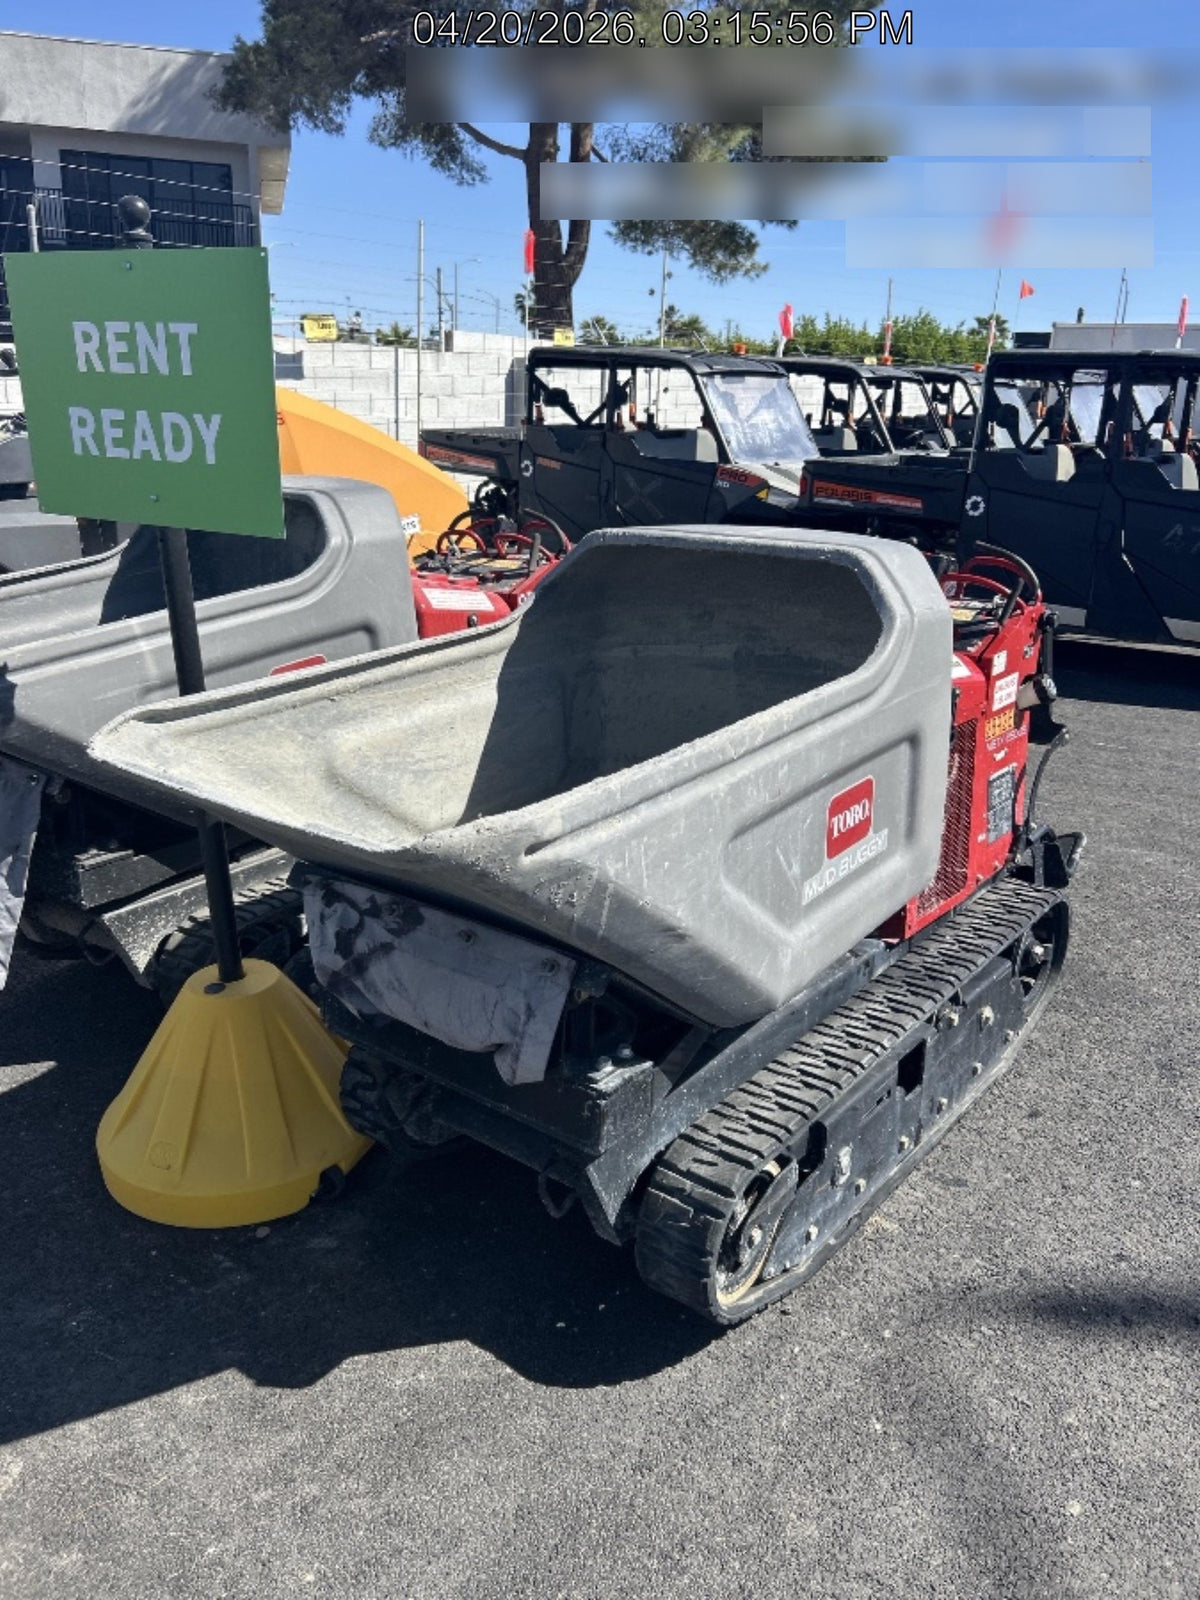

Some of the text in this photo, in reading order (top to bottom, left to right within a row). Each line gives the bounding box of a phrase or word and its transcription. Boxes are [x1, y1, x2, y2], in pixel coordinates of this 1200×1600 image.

[72, 321, 198, 376] RENT
[68, 406, 222, 465] READY
[719, 467, 748, 483] PRO
[815, 485, 872, 501] POLARIS
[830, 797, 870, 840] TORO
[803, 831, 888, 903] MUD BUGGY
